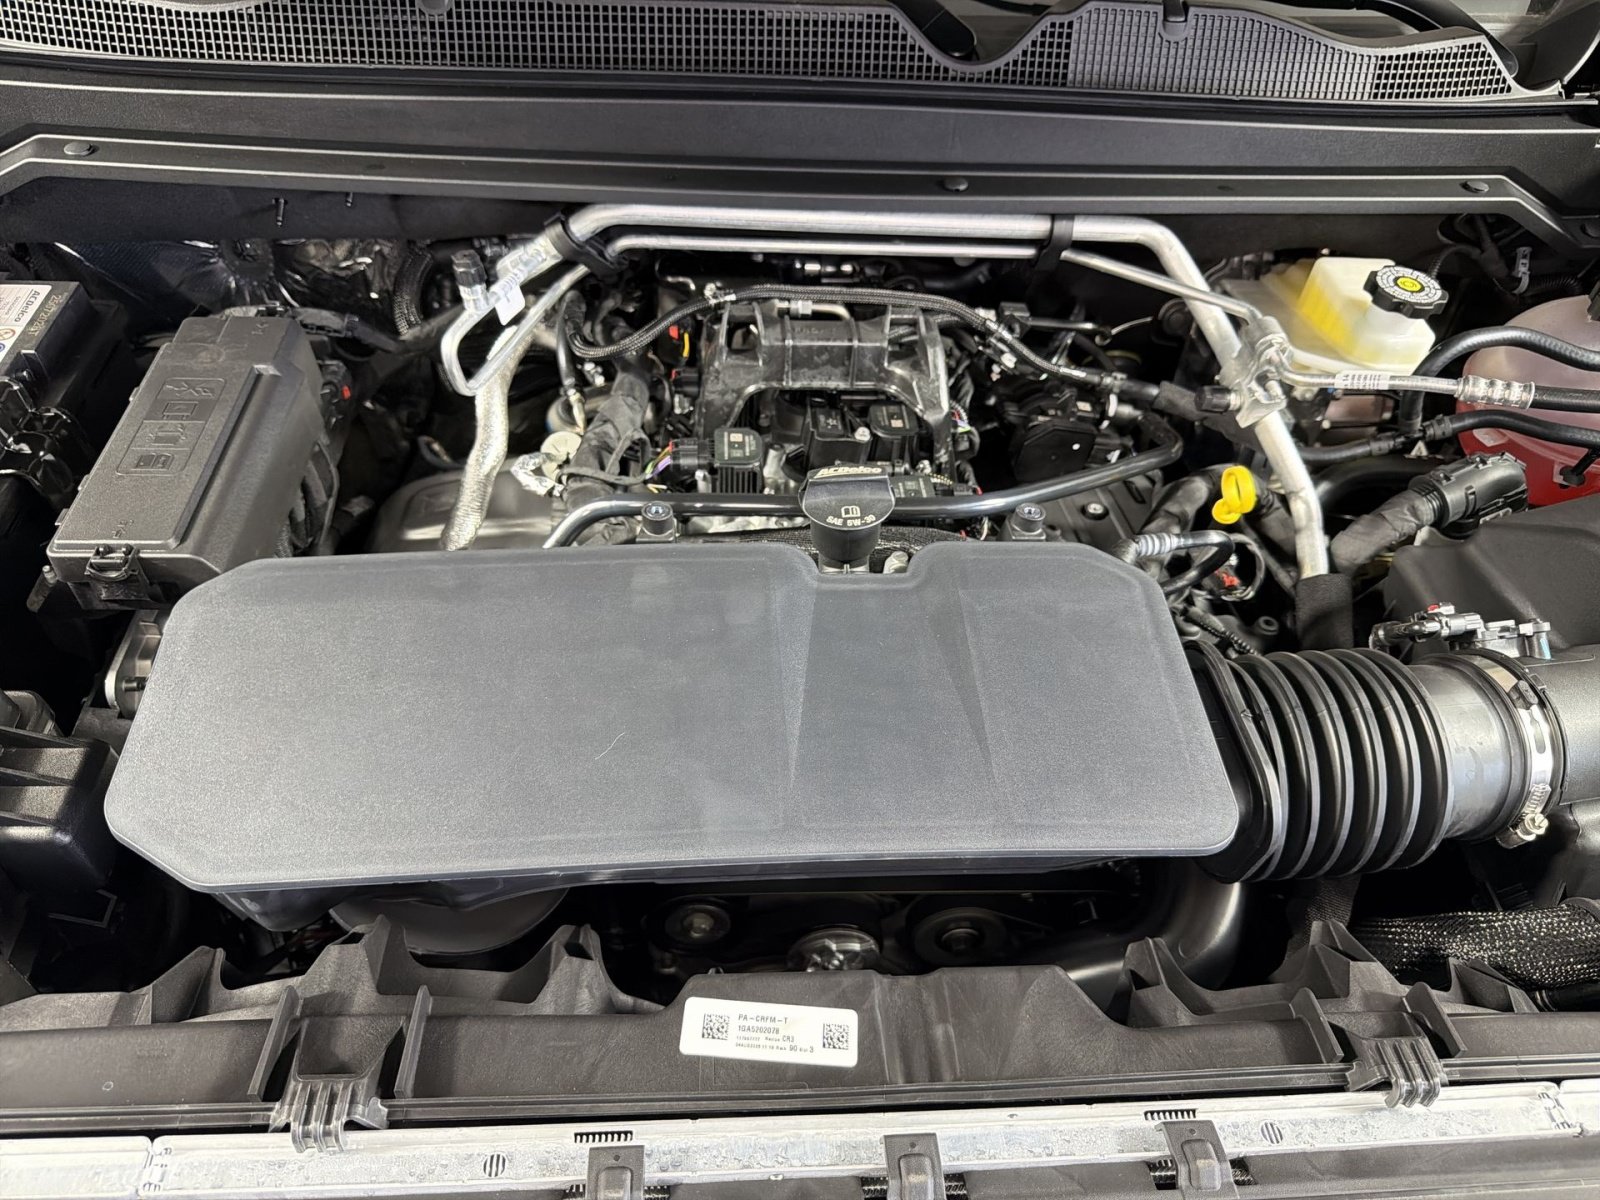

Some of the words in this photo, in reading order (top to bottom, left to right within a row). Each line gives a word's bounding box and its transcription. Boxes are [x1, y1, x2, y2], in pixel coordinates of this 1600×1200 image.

[14, 290, 41, 323] ACDelco
[826, 515, 844, 526] SAE
[846, 514, 876, 527] 5W-30
